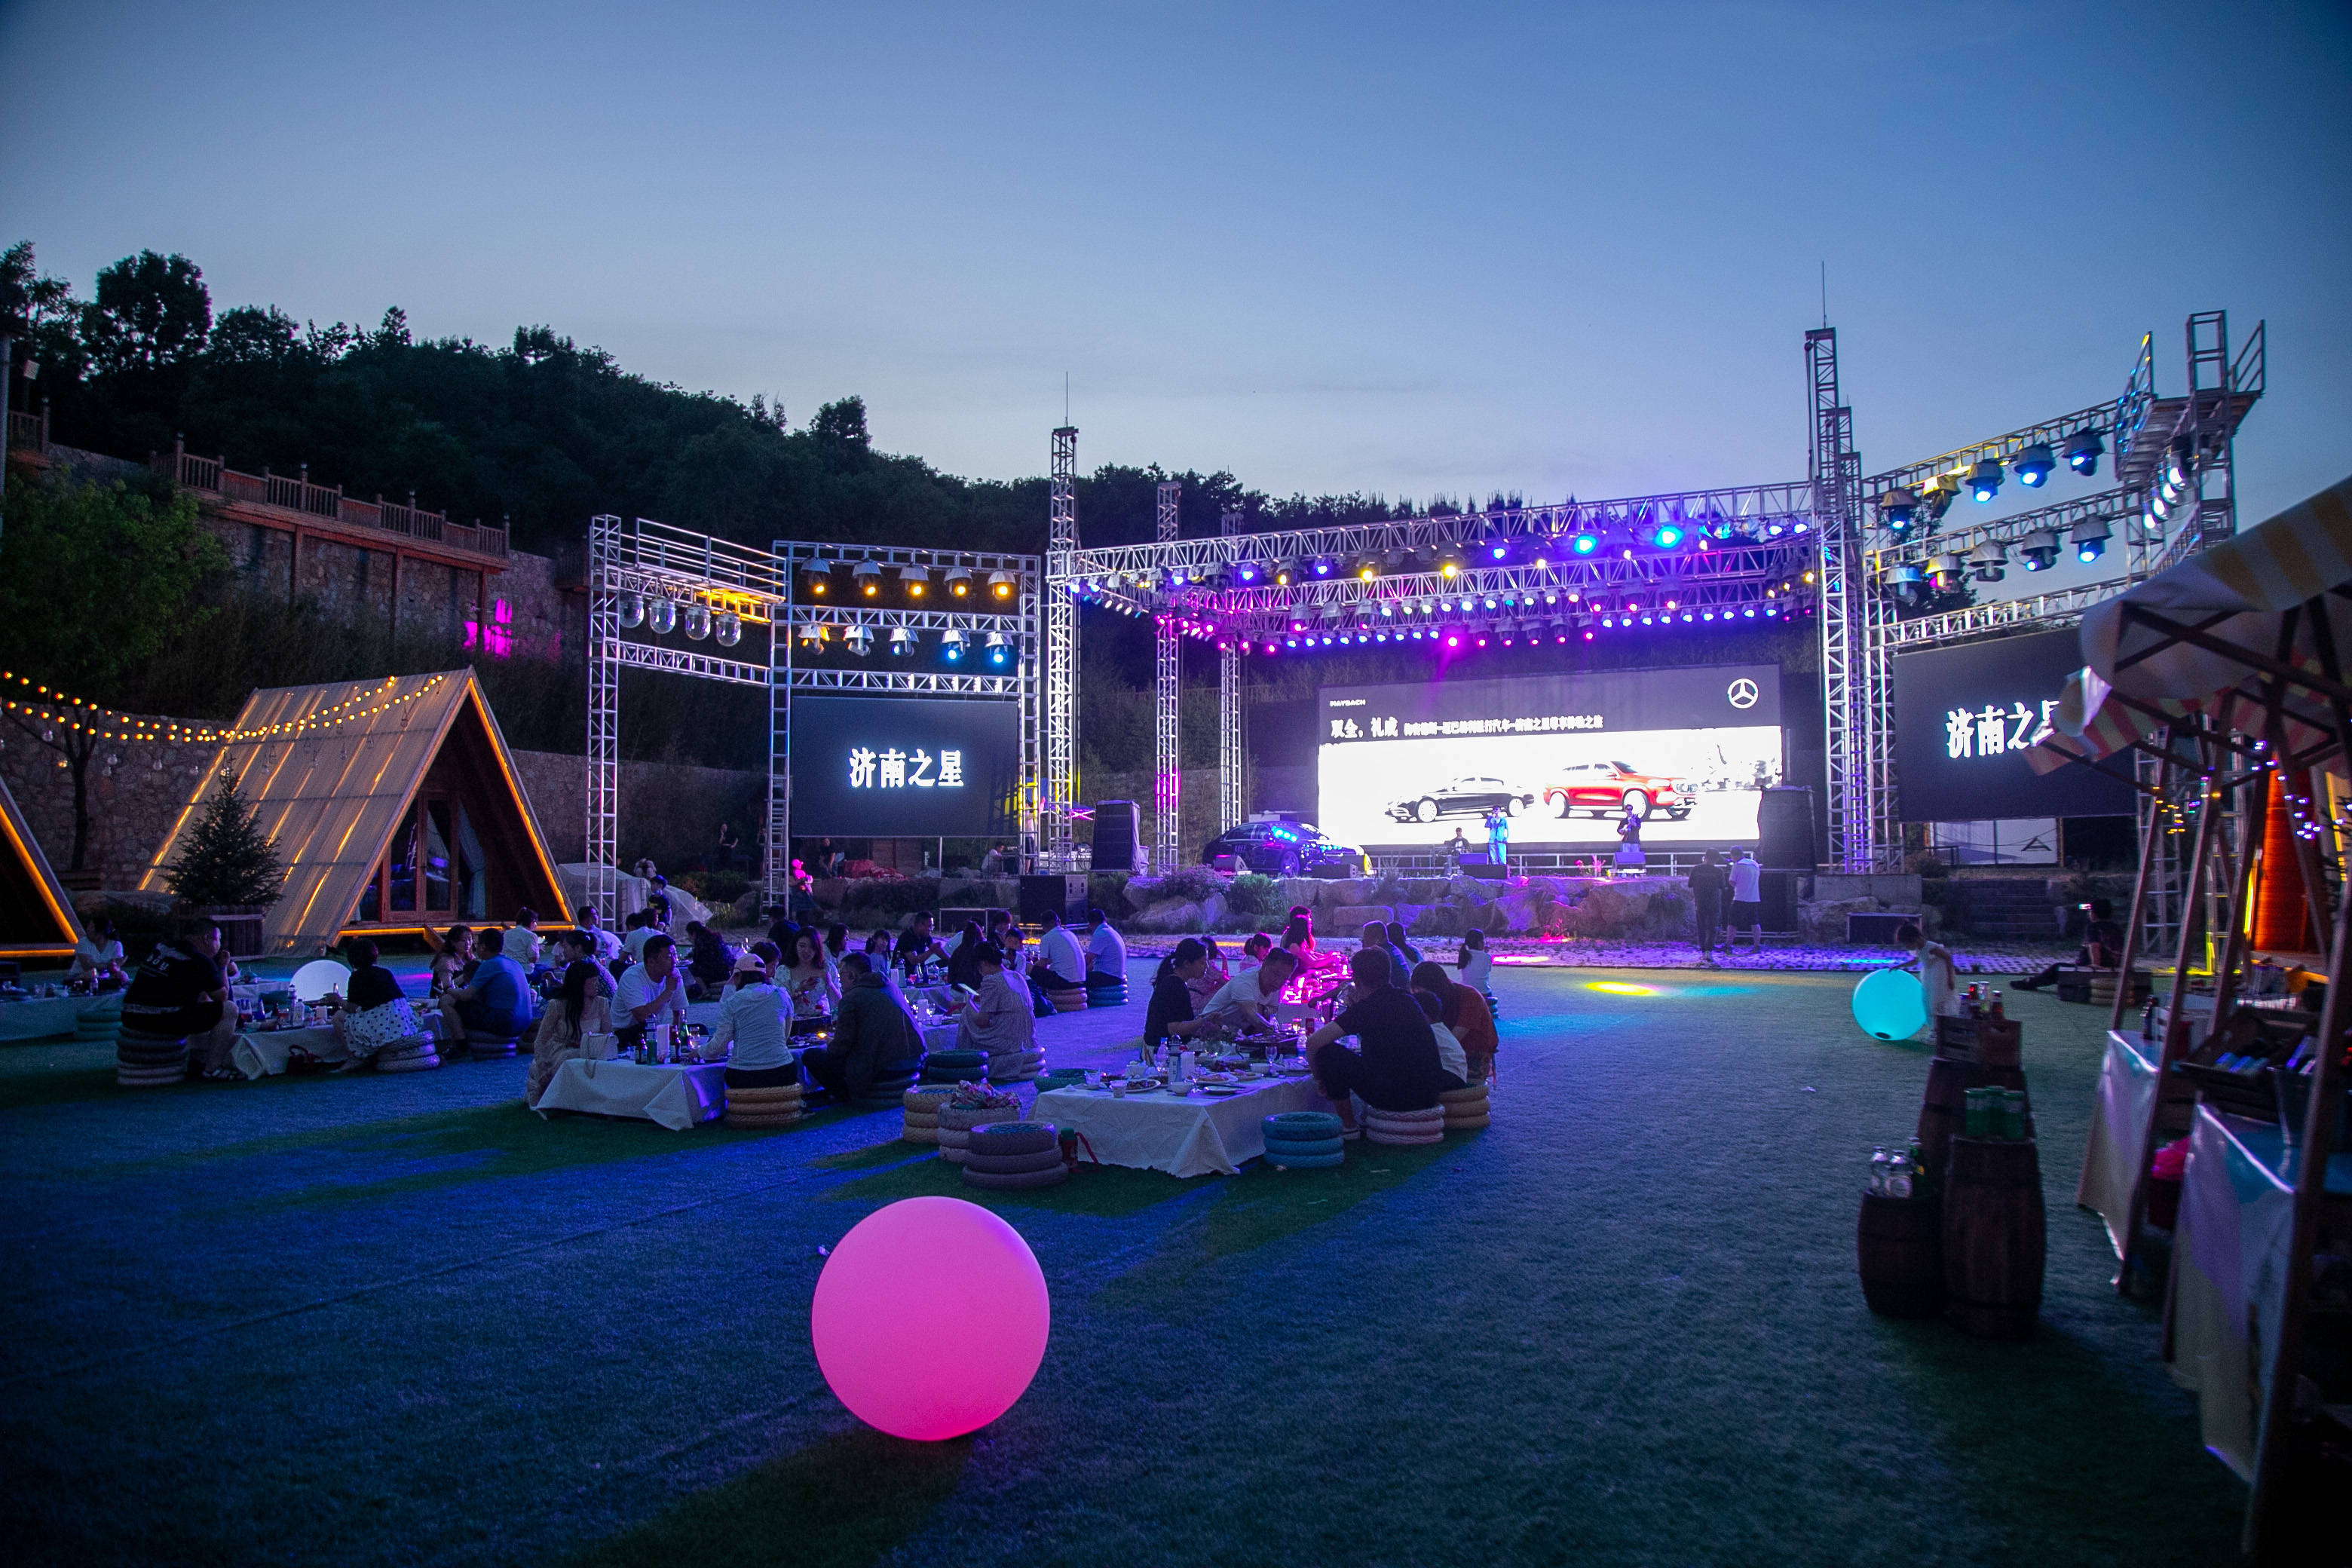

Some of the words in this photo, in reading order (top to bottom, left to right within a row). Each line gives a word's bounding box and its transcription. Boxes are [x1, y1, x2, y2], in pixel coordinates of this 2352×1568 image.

[1329, 699, 1366, 707] MAYBACH
[849, 747, 964, 789] 济南之星
